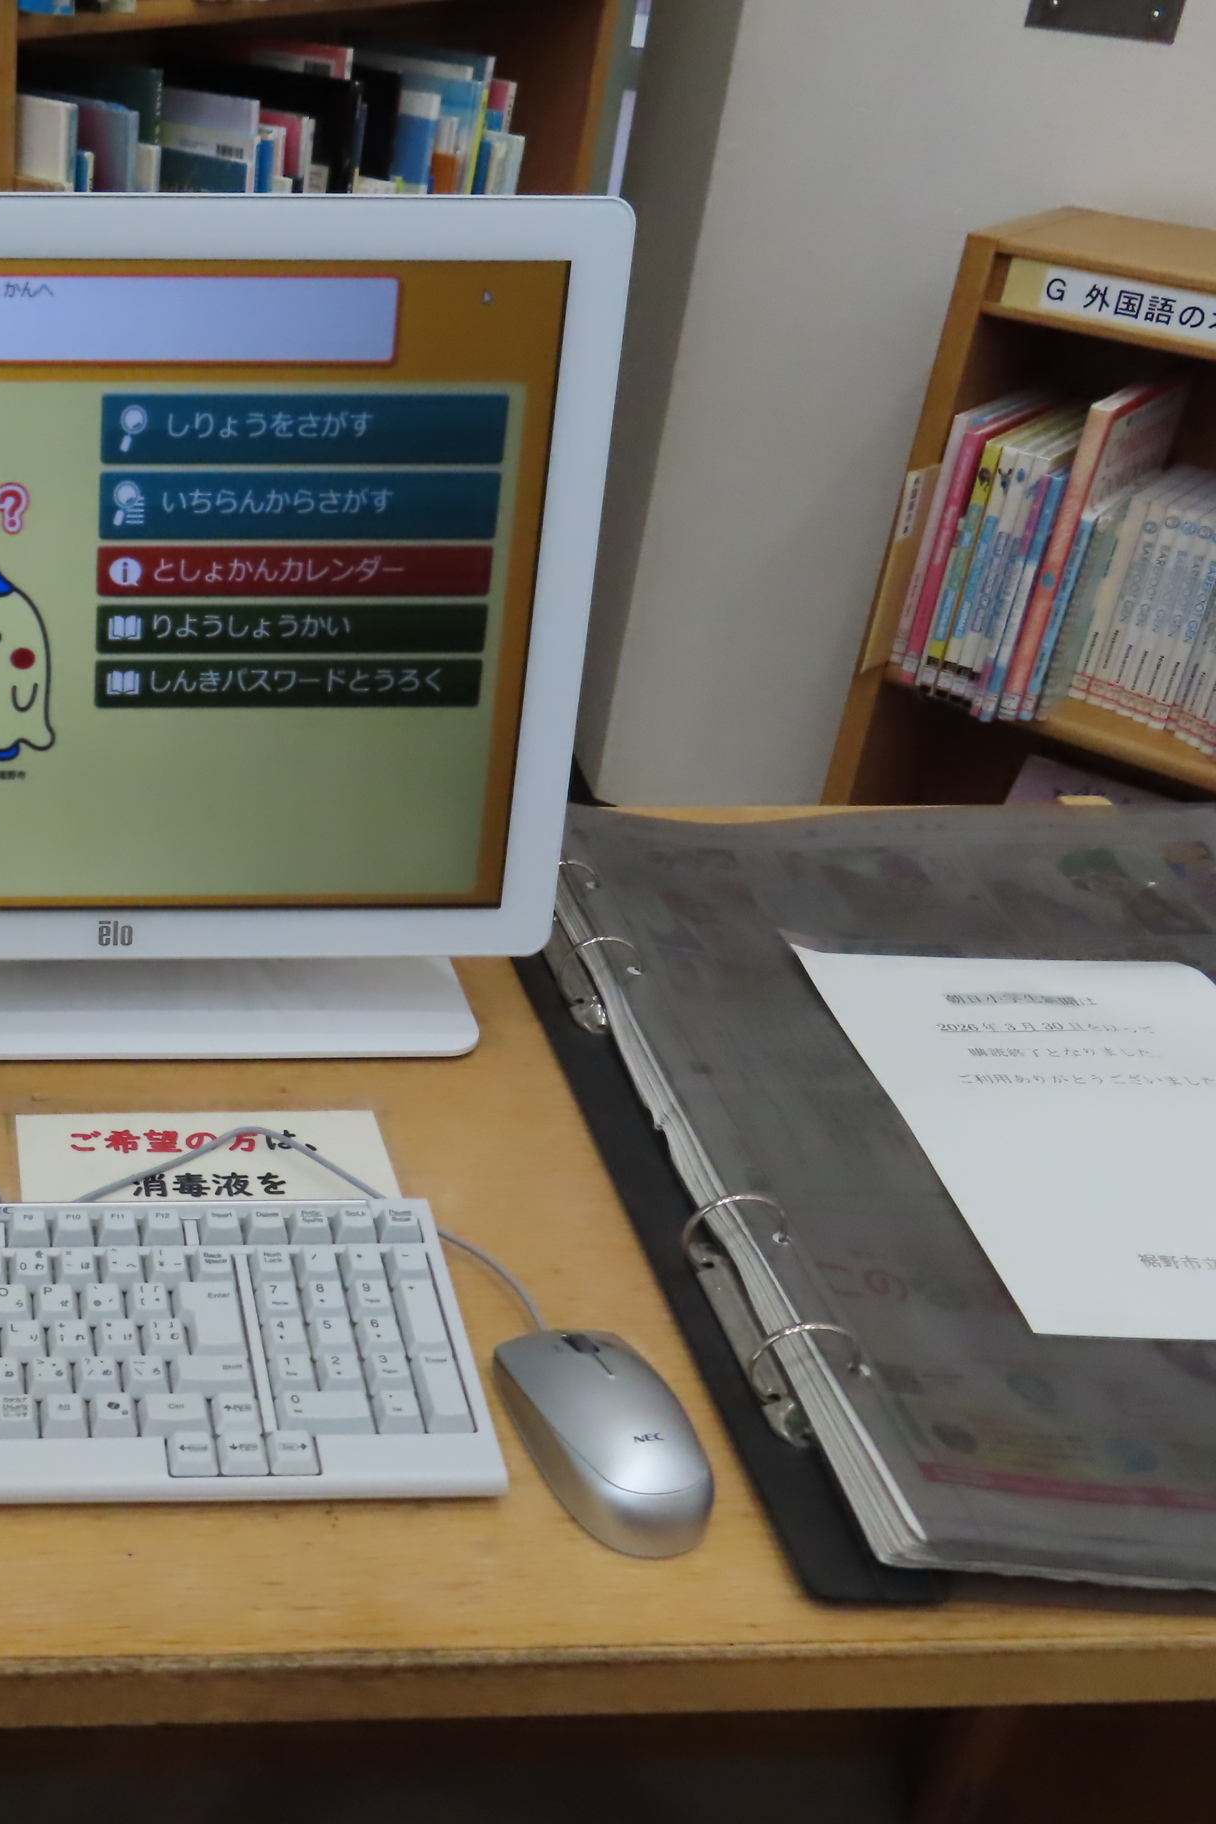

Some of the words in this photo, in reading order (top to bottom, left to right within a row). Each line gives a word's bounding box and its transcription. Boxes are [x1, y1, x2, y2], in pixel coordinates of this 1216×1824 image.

[1046, 278, 1067, 301] G
[1083, 283, 1216, 330] 外国語の
[167, 412, 374, 438] しりょうをさがす
[162, 488, 394, 514] いちらんからさがす
[153, 556, 404, 583] としょかんカレンダー
[152, 615, 351, 639] りようしょうかい
[150, 668, 443, 693] しんきパスワードとうろく
[132, 1172, 286, 1197] 消毒液を
[20, 1262, 27, 1270] 0
[44, 1287, 52, 1295] P
[270, 1285, 277, 1293] 7
[316, 1284, 324, 1292] 8
[362, 1283, 370, 1292] 9
[277, 1321, 284, 1329] 4
[323, 1320, 331, 1329] 5
[370, 1319, 379, 1327] 6
[11, 1324, 18, 1332] L
[331, 1356, 340, 1364] 2
[379, 1355, 387, 1363] 3
[291, 1395, 300, 1403] 0
[632, 1432, 665, 1444] NEC
